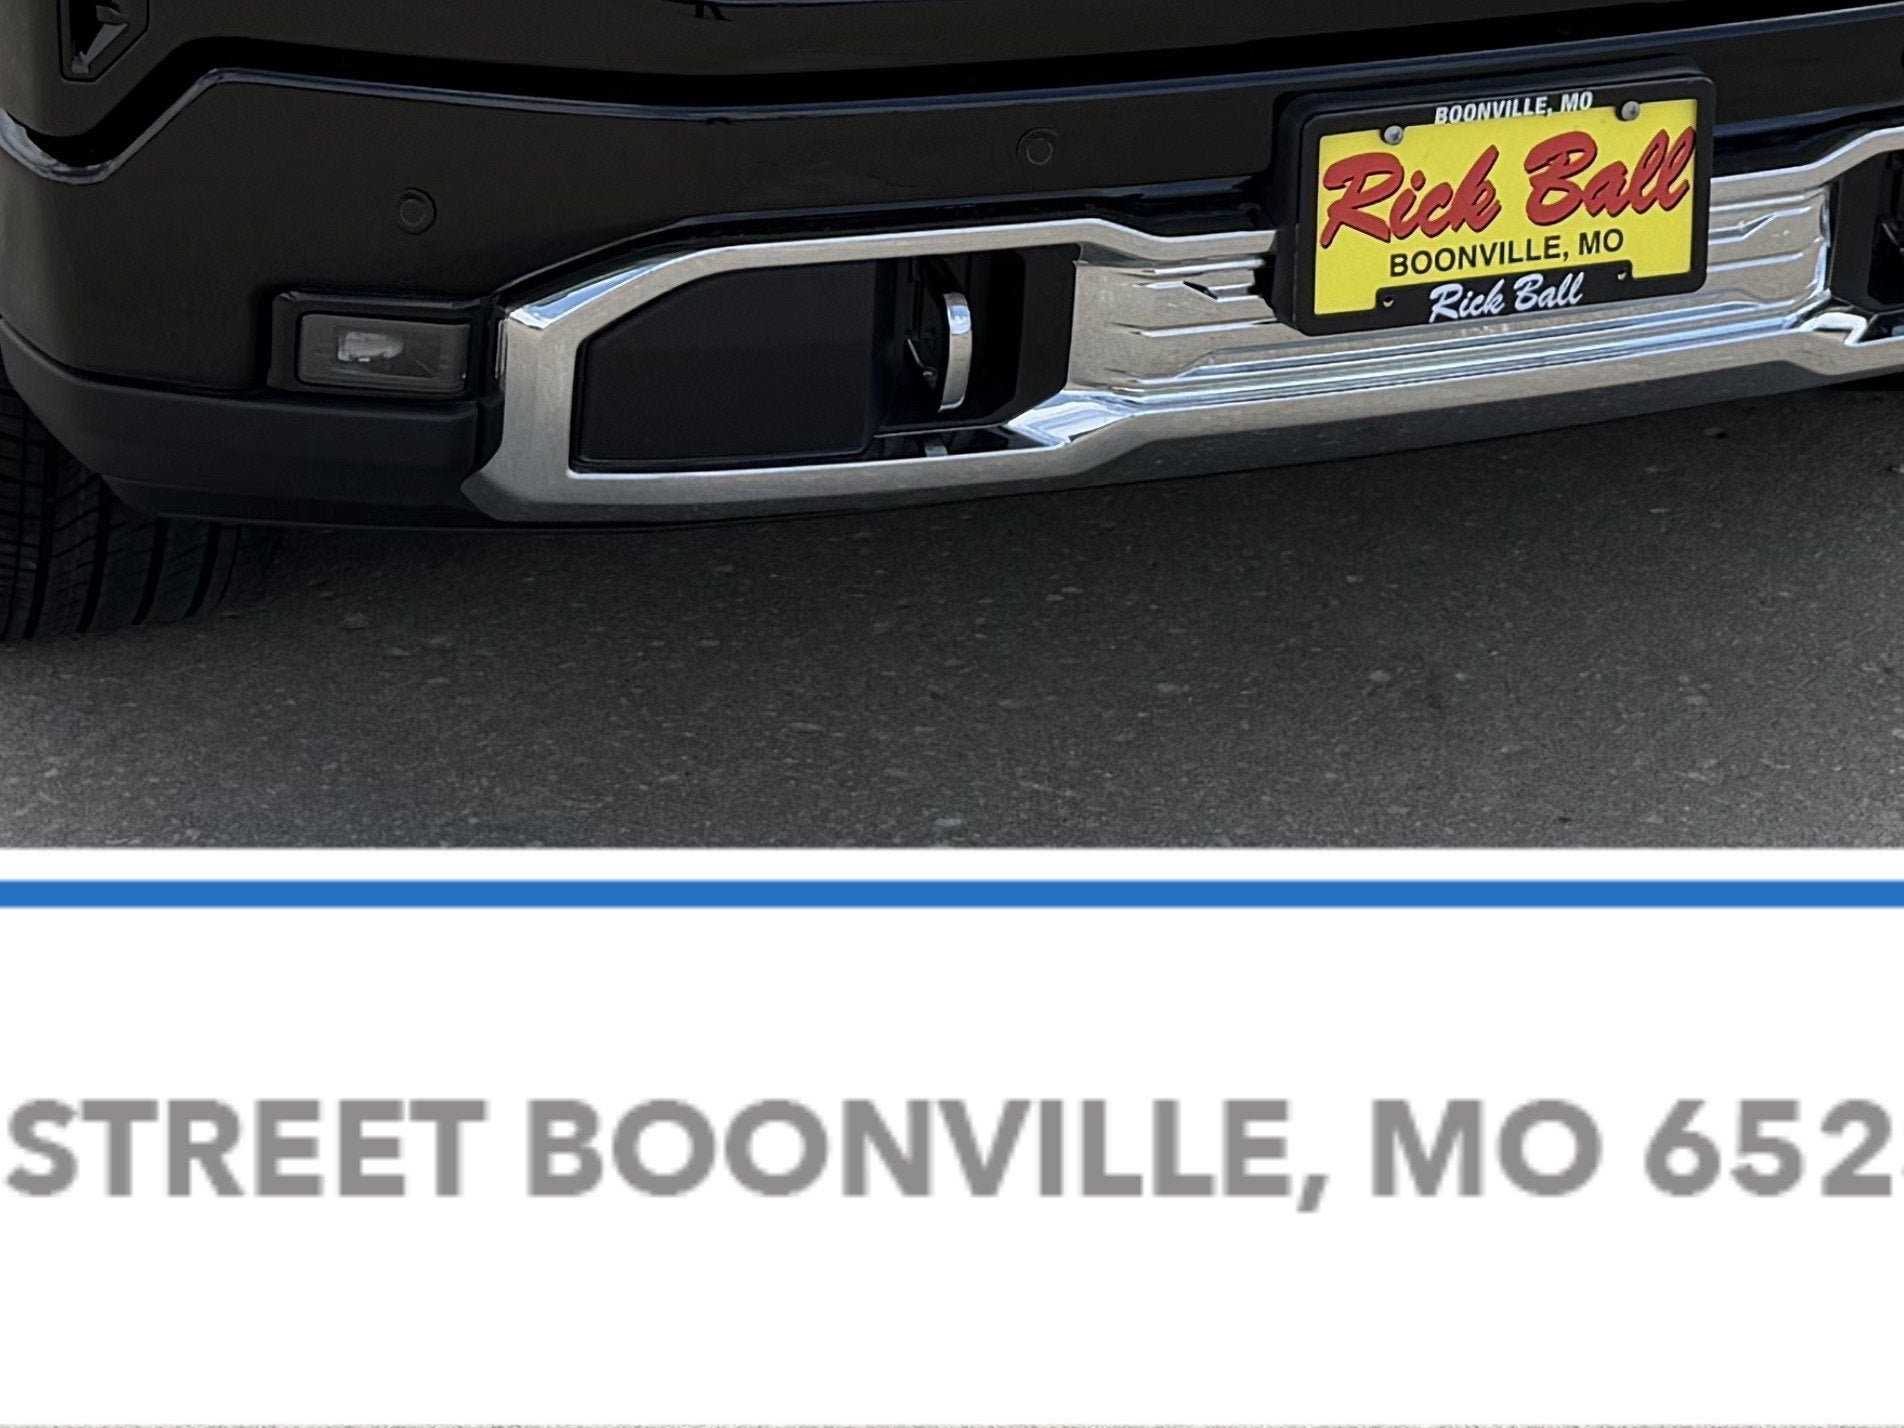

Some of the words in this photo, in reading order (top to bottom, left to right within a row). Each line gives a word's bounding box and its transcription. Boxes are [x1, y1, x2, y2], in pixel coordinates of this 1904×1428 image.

[1434, 95, 1553, 126] BOONVILLE,
[1560, 90, 1593, 112] MO
[1319, 144, 1503, 250] Rick
[1523, 125, 1696, 227] Ball
[1389, 234, 1570, 278] BOONVILLE,
[1578, 228, 1624, 256] MO
[1428, 277, 1506, 324] Rick
[1513, 271, 1586, 311] Ball
